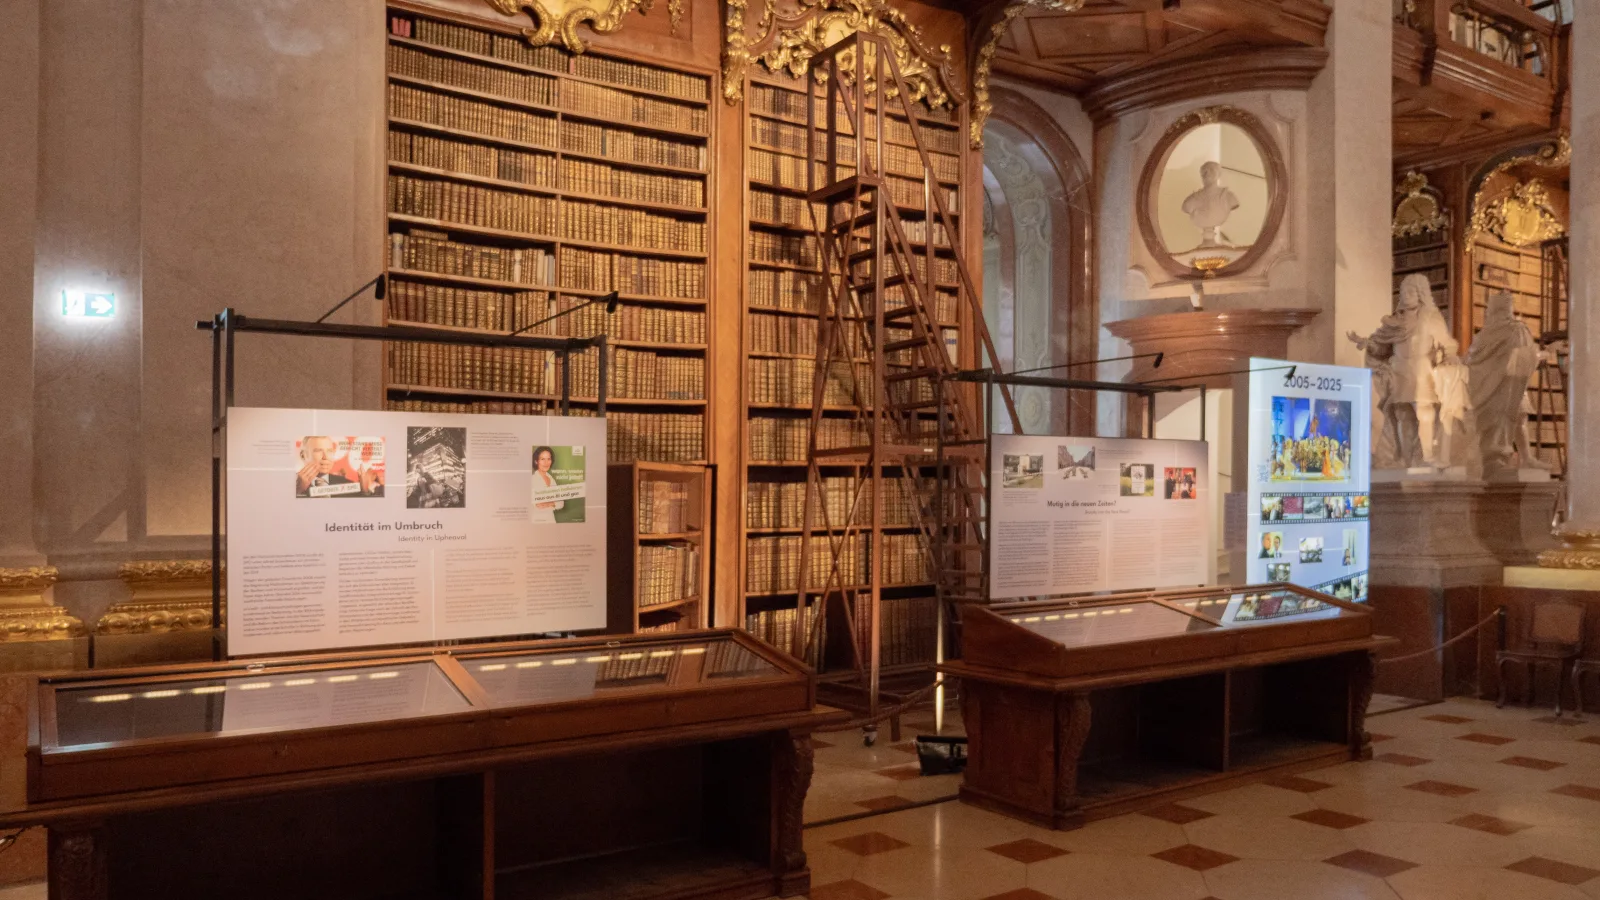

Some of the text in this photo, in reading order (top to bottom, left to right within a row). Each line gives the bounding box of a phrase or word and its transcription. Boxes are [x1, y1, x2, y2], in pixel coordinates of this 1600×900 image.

[325, 520, 443, 532] Identität im Umbruch
[434, 534, 467, 542] Upheaval
